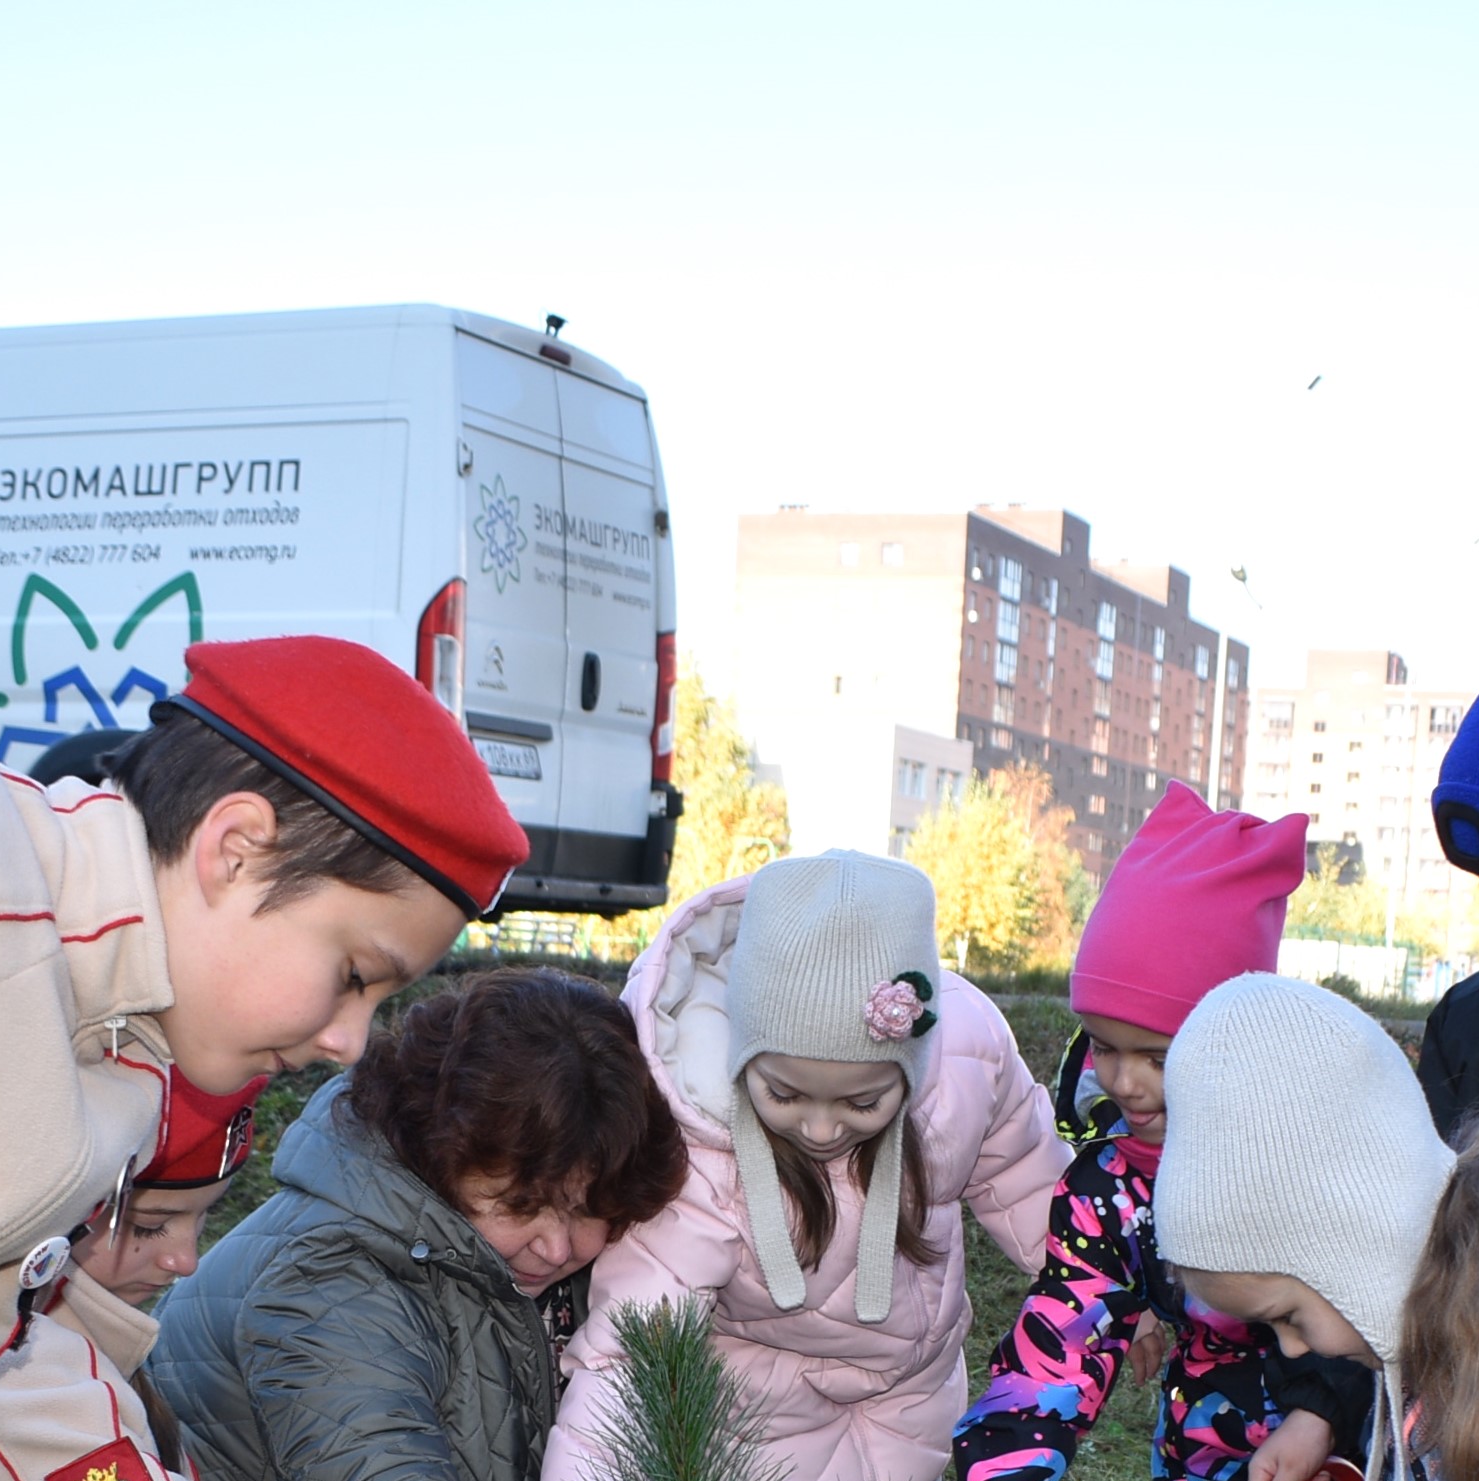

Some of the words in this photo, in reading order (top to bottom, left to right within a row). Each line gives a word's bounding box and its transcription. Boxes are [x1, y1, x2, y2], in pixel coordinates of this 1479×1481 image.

[100, 501, 219, 534] переработки
[222, 499, 301, 527] отходов
[534, 502, 651, 561] ЭКОМАШГРУПП
[46, 544, 95, 567] (4822)
[99, 543, 128, 563] 777
[131, 542, 162, 562] 604
[189, 543, 297, 564] www.ecomg.ru
